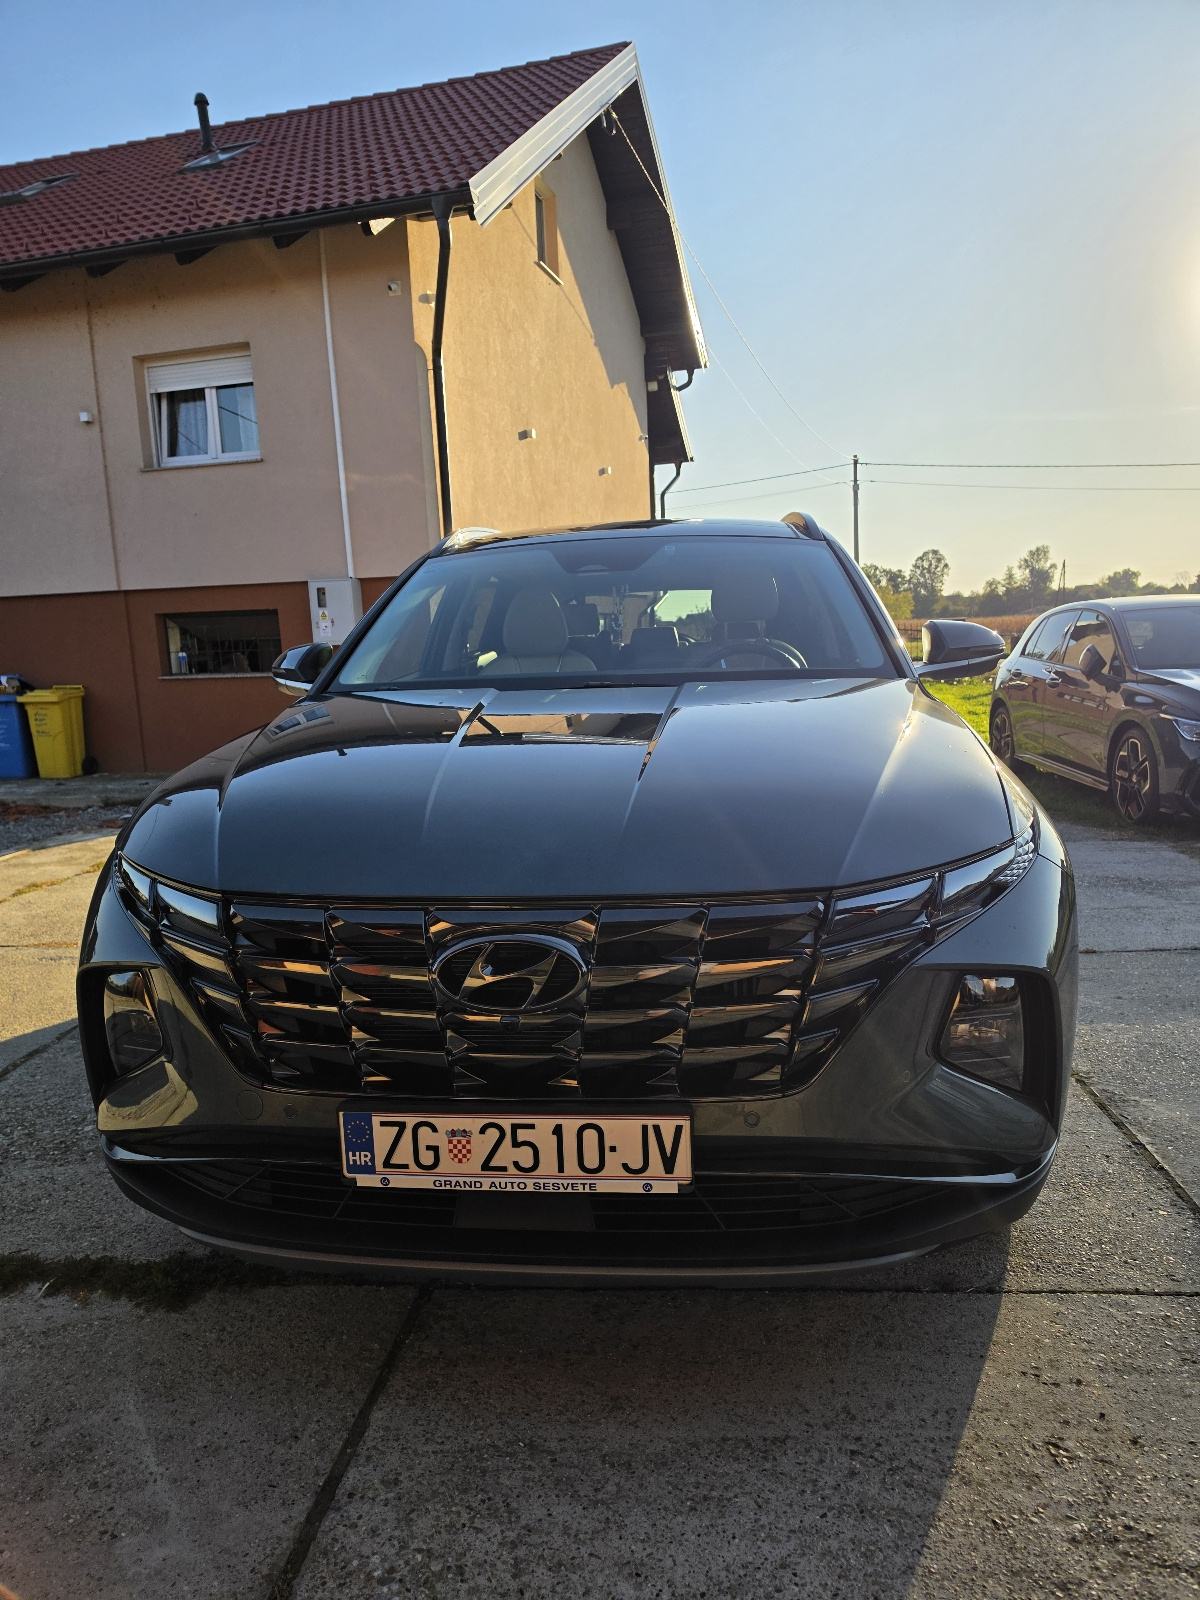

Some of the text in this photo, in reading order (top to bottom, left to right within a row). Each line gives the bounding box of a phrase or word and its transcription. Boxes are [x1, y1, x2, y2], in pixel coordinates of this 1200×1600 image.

[379, 1120, 441, 1171] ZG
[348, 1151, 372, 1166] HR
[432, 1179, 597, 1192] GRAND AUTO SESVETE
